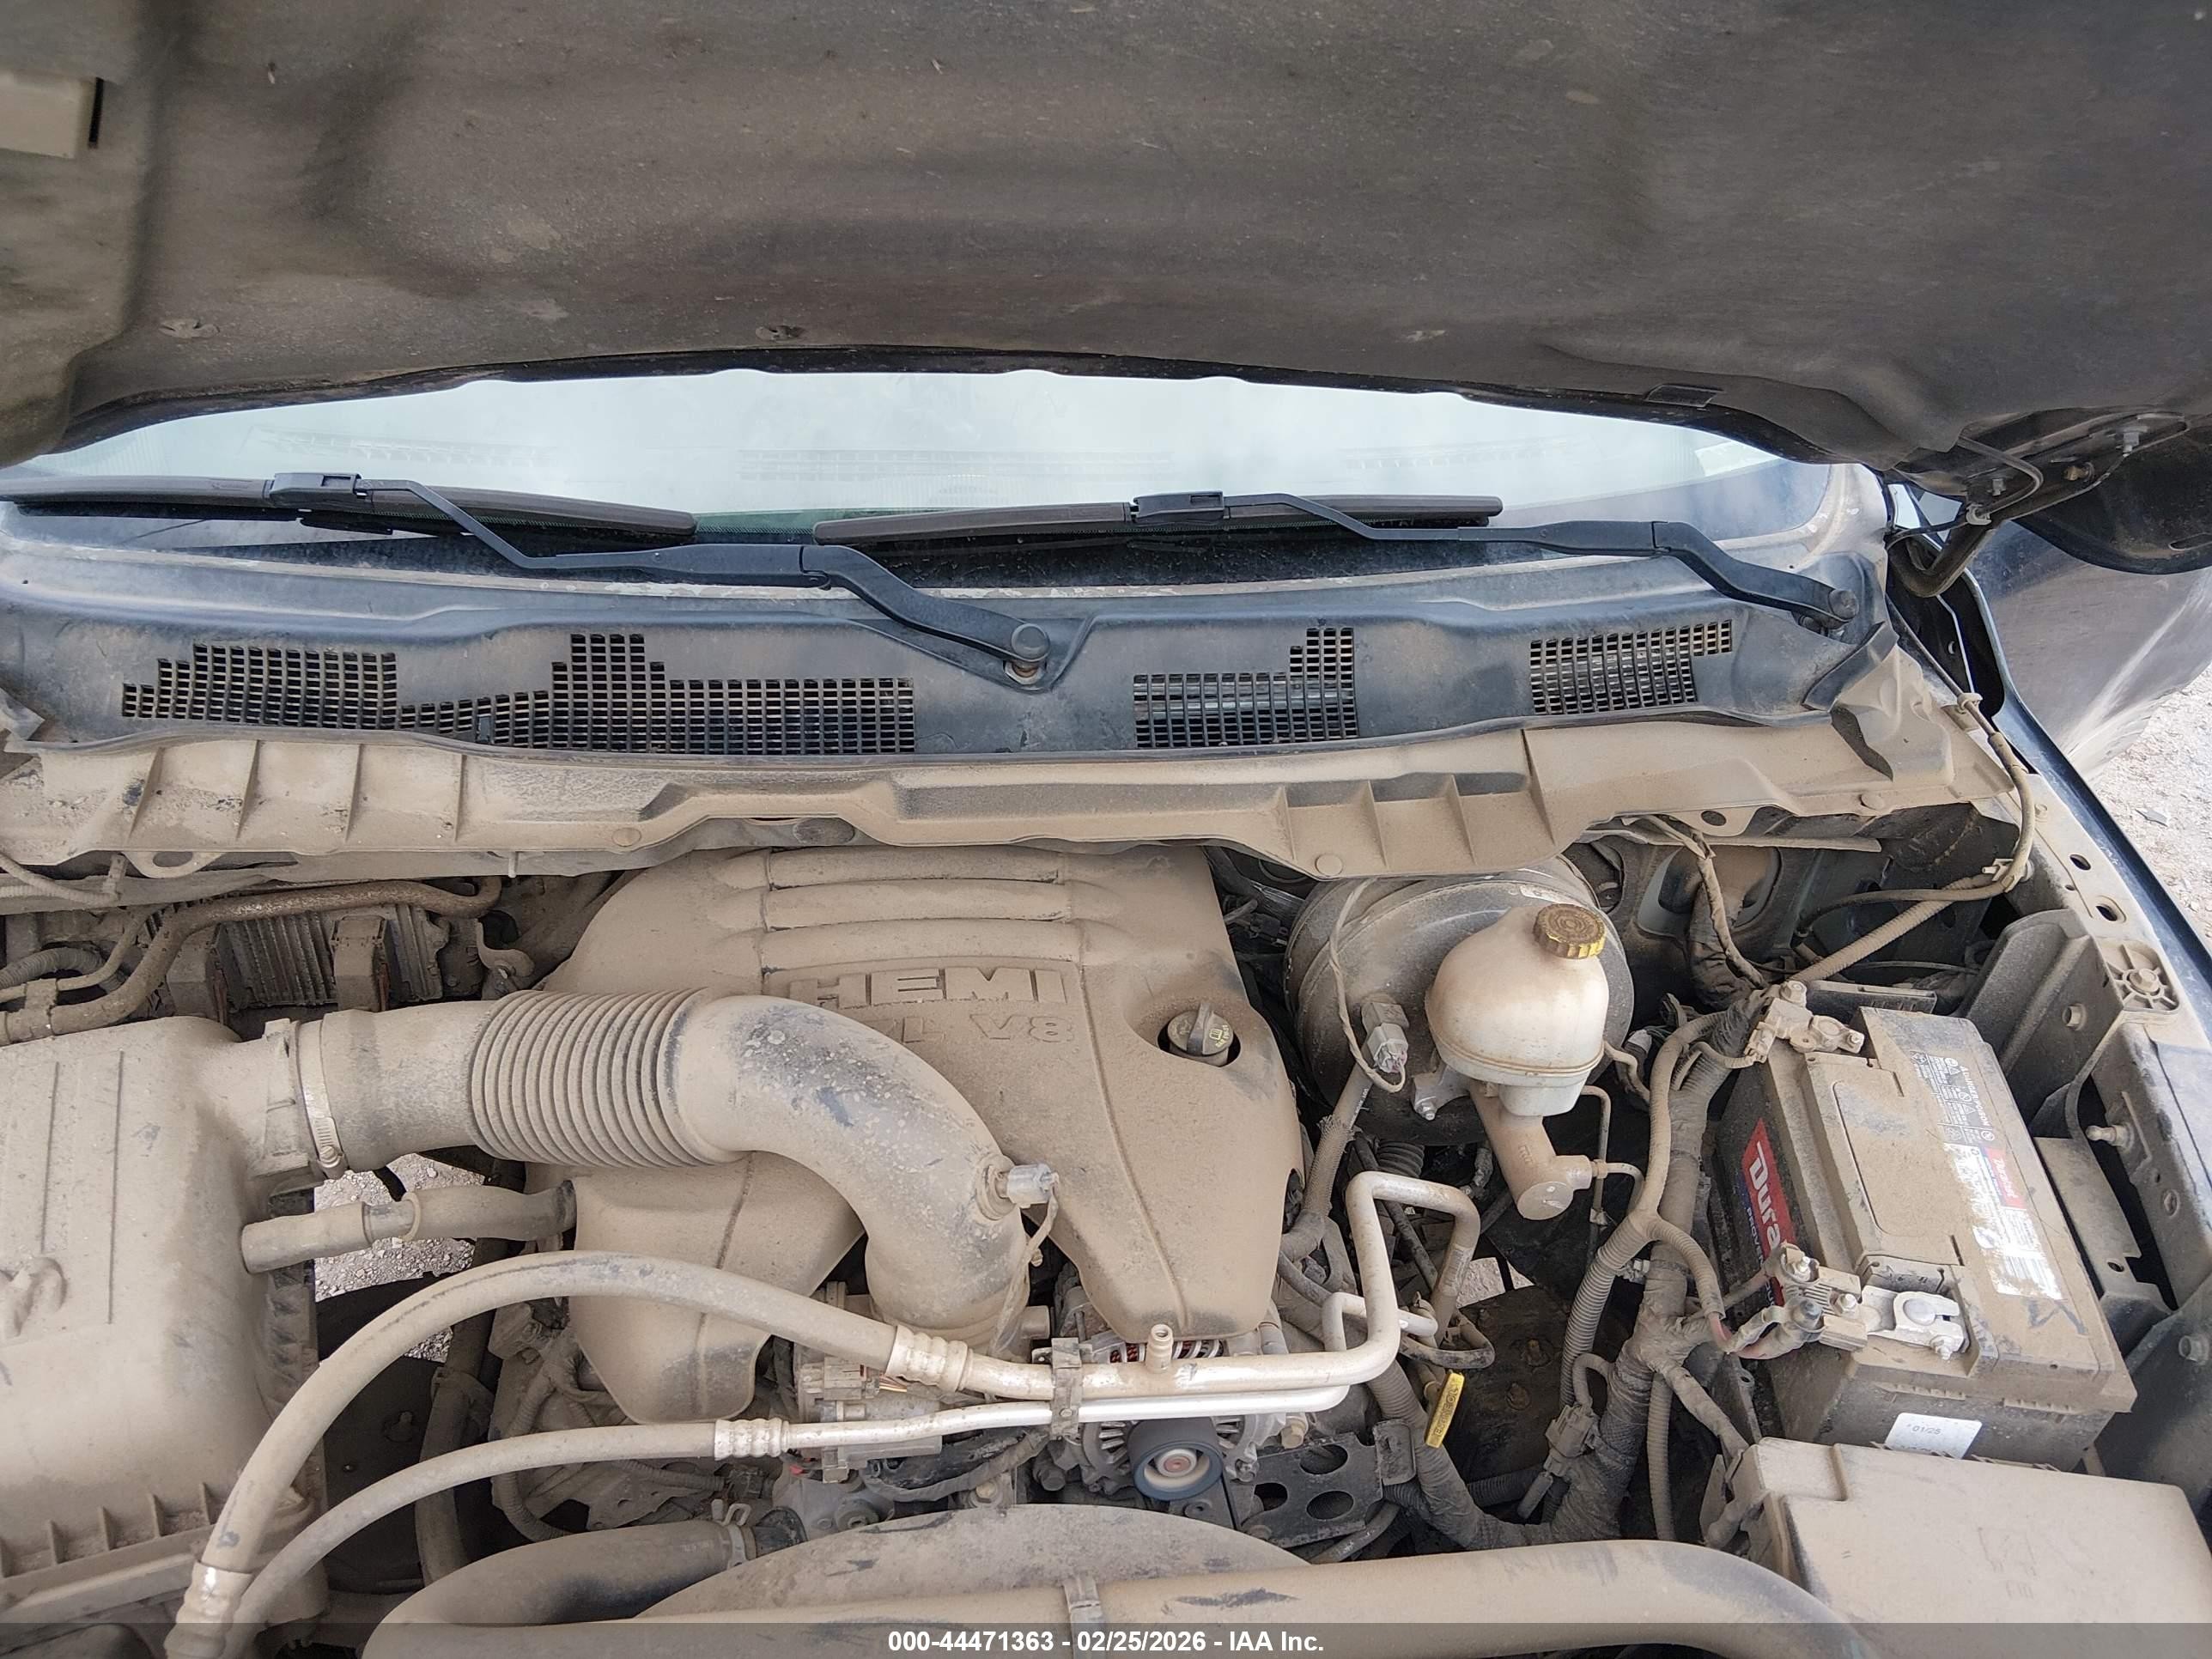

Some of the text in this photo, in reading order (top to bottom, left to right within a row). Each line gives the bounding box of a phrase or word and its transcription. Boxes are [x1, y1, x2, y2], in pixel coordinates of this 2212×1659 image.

[788, 965, 1067, 1010] HEMI
[969, 1013, 1075, 1042] V8
[1749, 1140, 1781, 1250] Dura
[1446, 1388, 1459, 1403] OIL
[1911, 1425, 1942, 1435] 01/25
